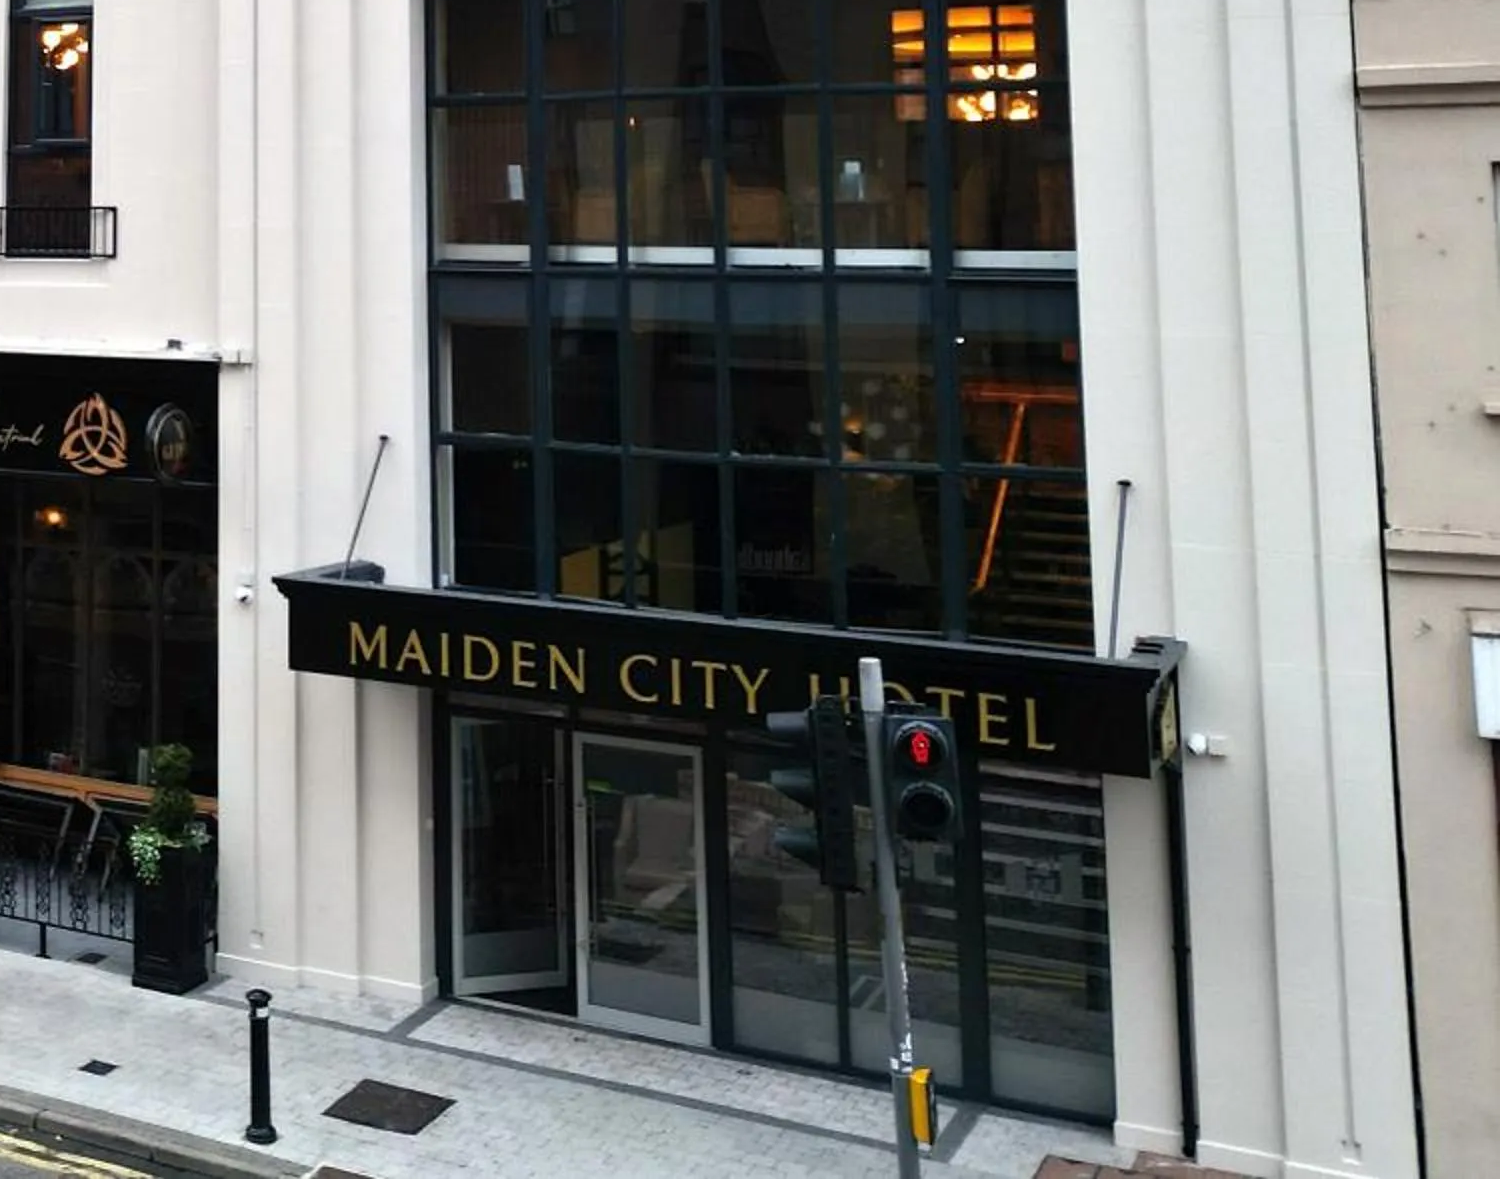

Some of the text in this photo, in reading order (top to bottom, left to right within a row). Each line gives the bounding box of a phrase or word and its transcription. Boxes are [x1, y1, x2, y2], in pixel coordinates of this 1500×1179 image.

[349, 621, 1057, 752] MAIDEN CITY HTEL
